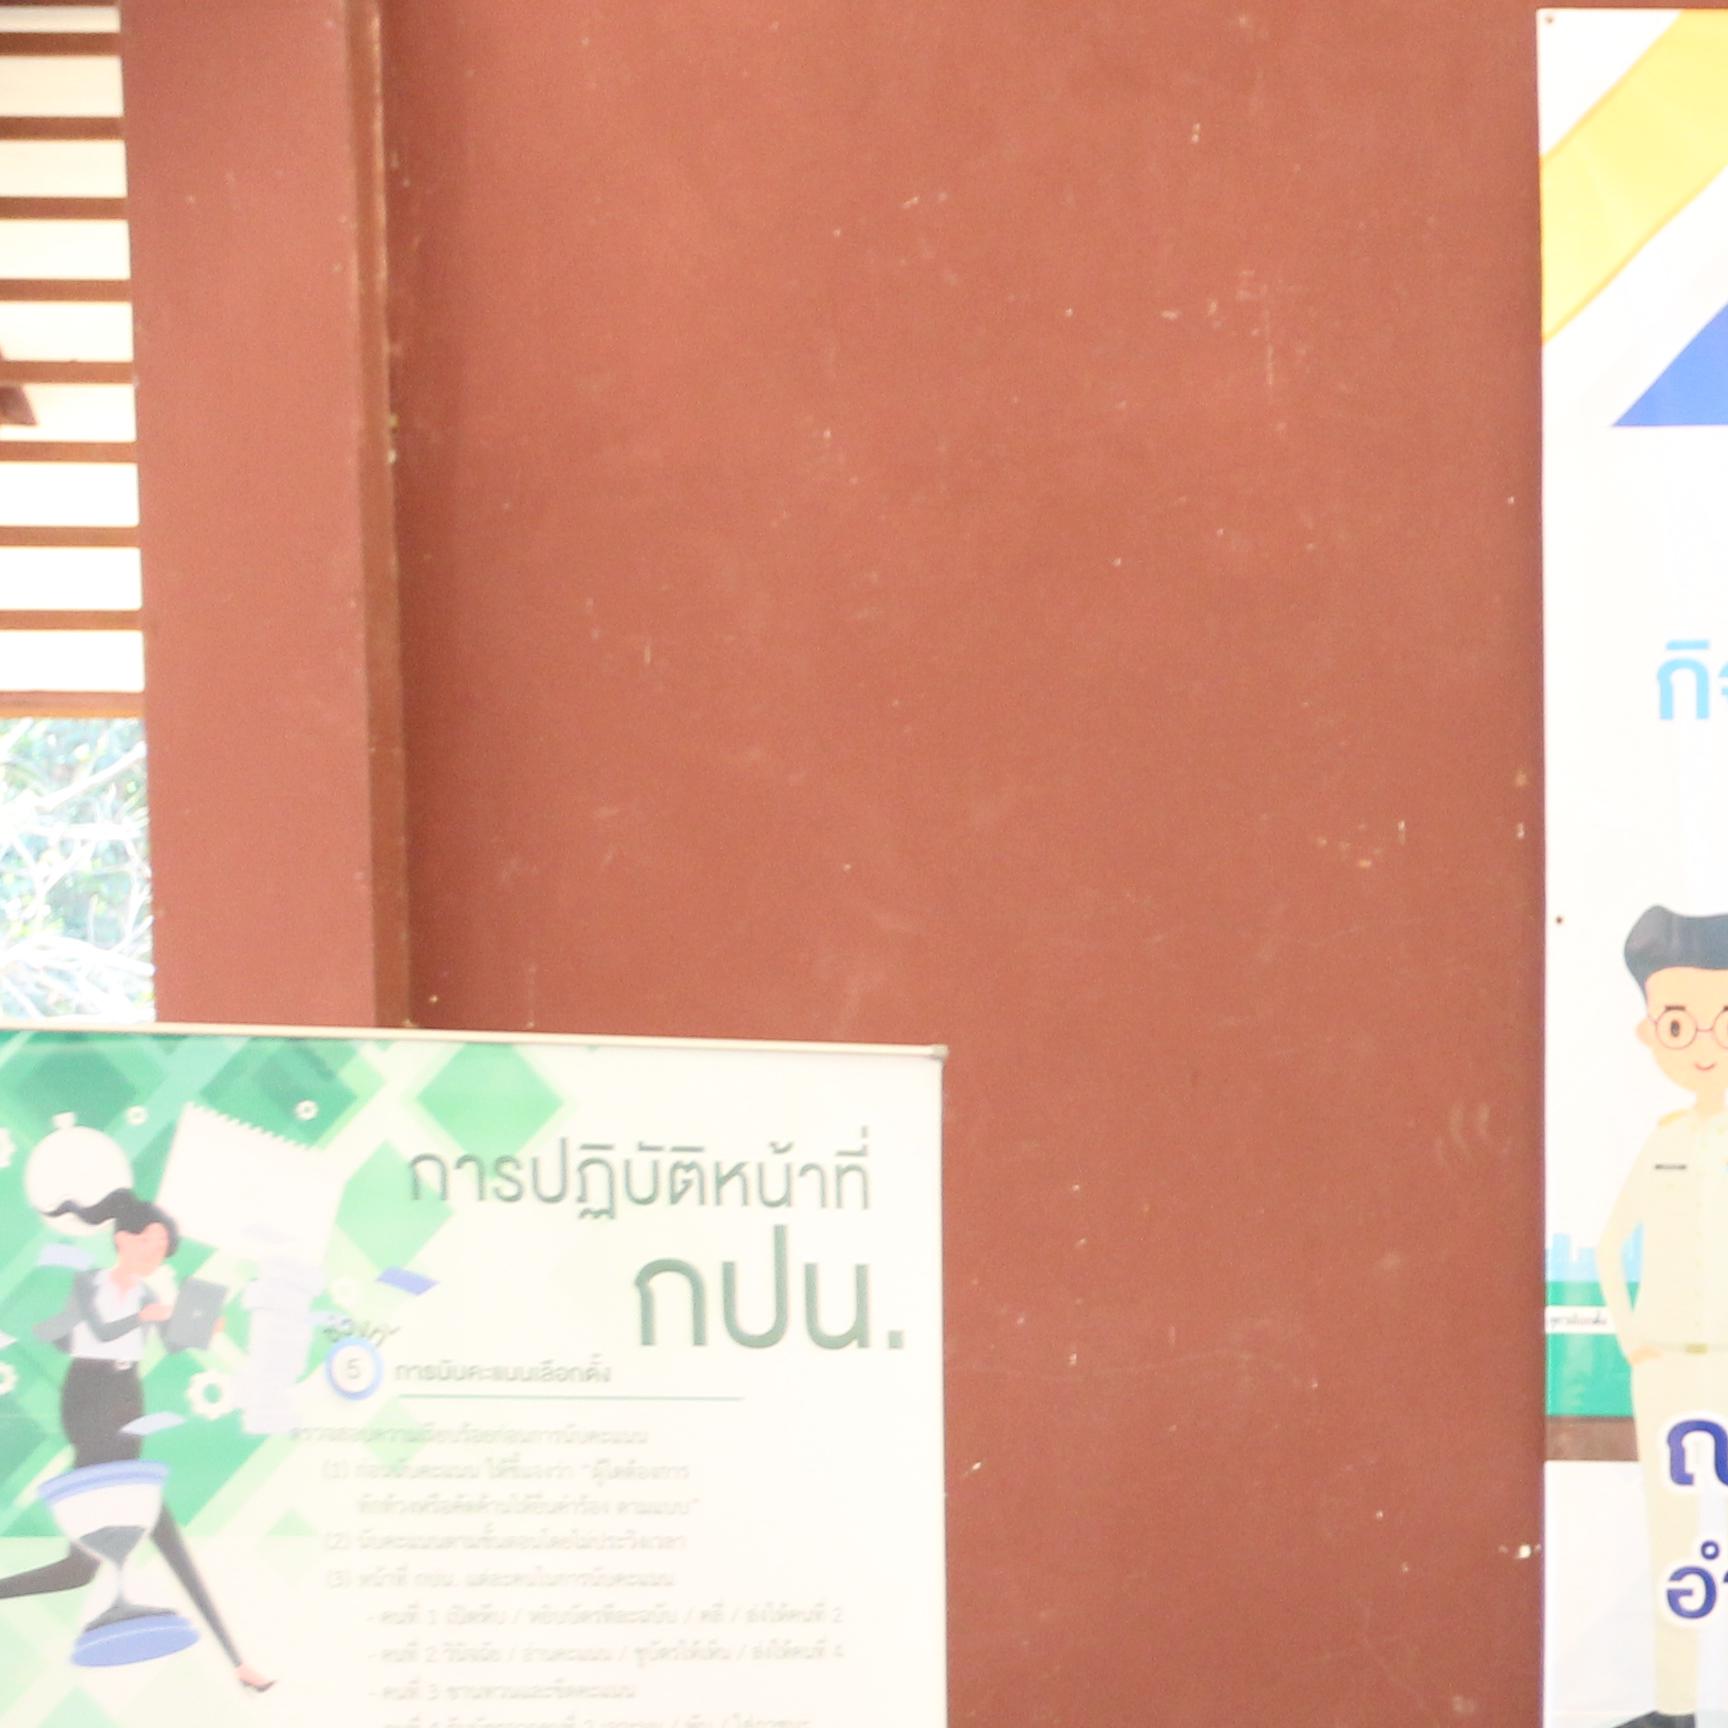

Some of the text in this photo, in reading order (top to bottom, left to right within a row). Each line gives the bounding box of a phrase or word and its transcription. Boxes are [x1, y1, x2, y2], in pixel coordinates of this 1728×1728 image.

[408, 1125, 871, 1221] การปฏิบัติหน้าที่
[632, 1223, 907, 1350] กปน.
